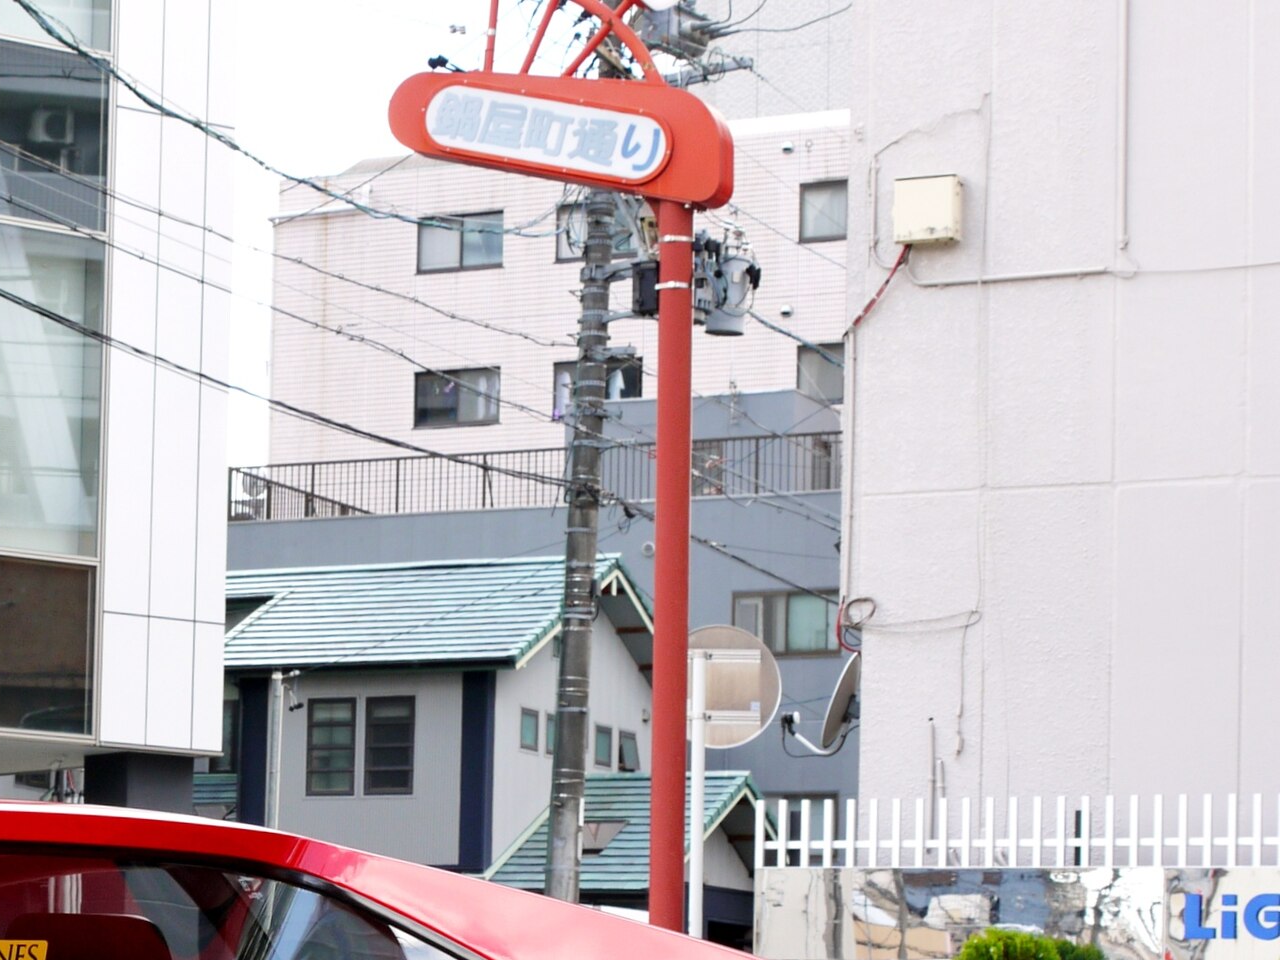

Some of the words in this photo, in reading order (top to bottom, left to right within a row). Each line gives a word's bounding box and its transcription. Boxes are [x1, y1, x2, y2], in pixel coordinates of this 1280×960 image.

[431, 92, 660, 172] 鍋屋町通り
